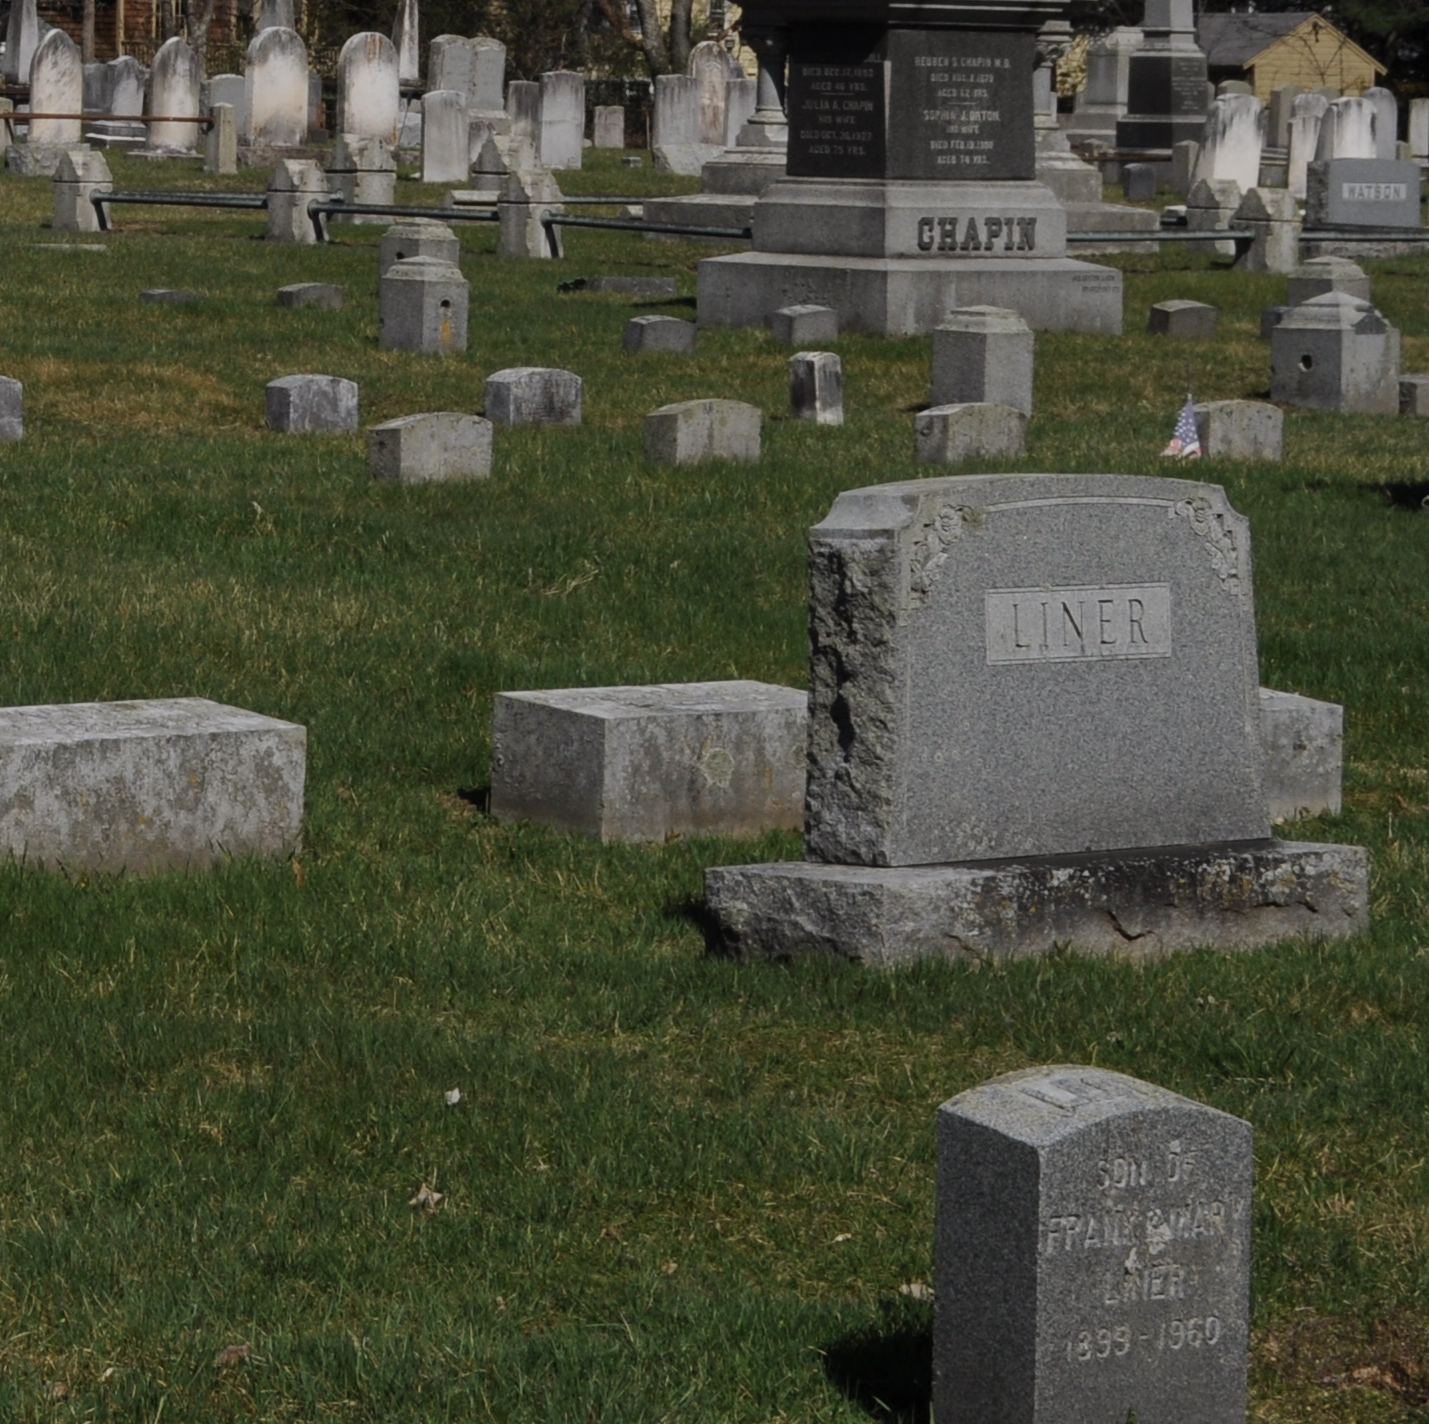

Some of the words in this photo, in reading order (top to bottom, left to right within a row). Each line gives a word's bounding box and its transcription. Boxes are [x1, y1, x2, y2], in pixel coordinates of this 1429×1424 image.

[802, 67, 821, 76] DIED
[802, 99, 830, 110] JULIA
[1348, 185, 1401, 200] WATSON
[917, 216, 1037, 252] CHAPIN
[1012, 598, 1149, 653] LINER
[1097, 1156, 1147, 1190] SON
[1066, 1325, 1131, 1363] 1899
